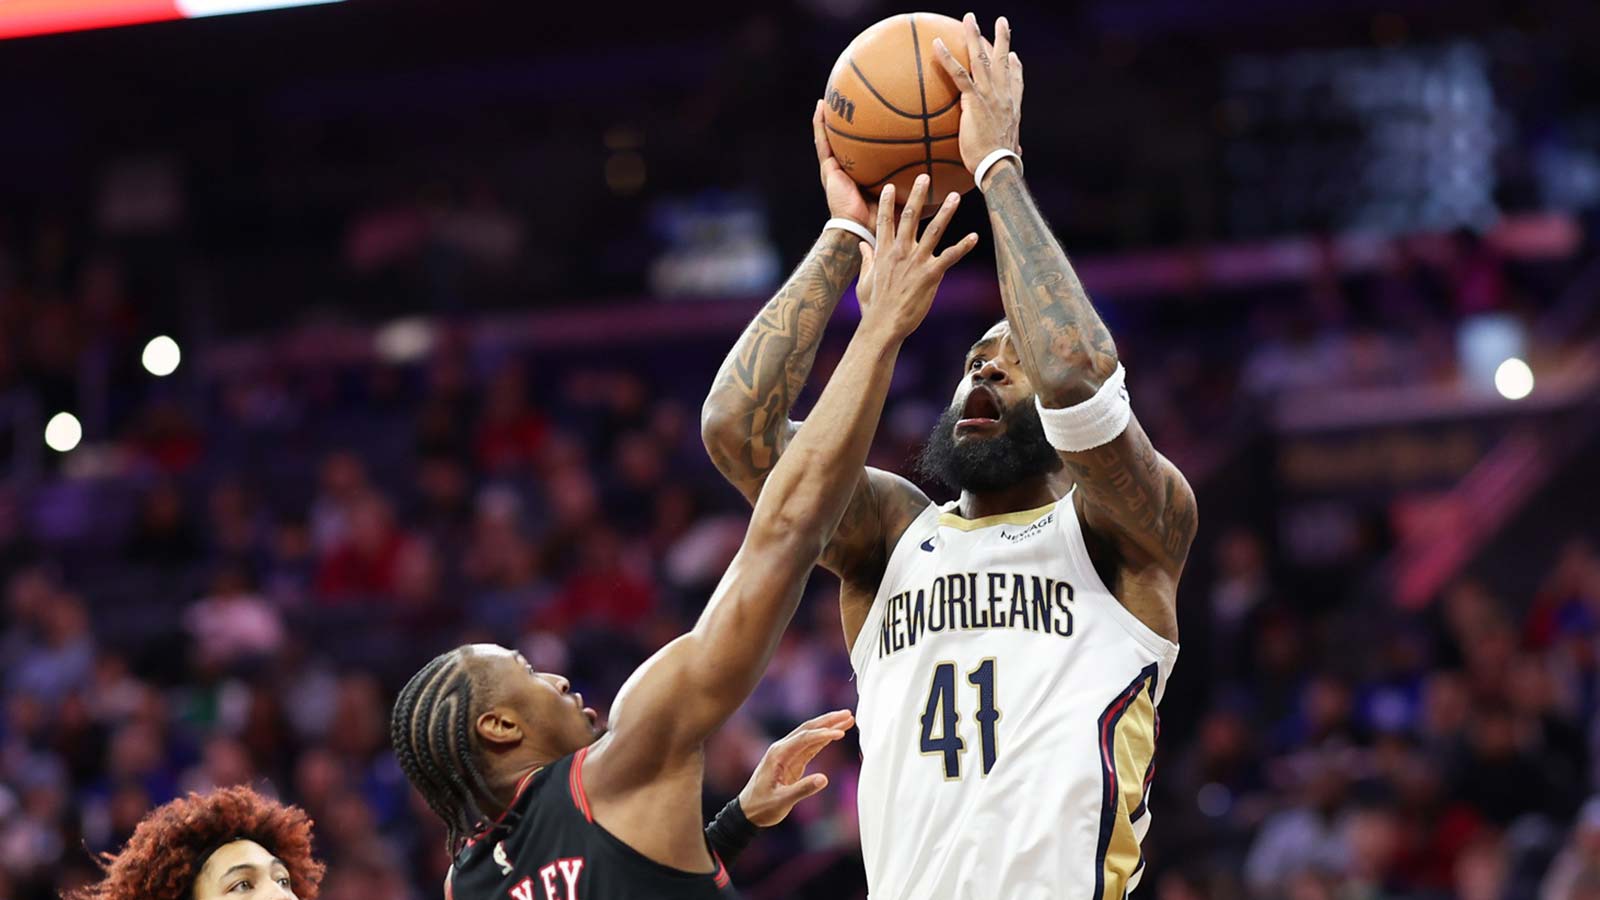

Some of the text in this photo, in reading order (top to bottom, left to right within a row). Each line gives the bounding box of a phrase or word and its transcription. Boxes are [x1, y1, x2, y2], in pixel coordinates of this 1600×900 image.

[878, 571, 1075, 660] NEW ORLEANS
[918, 656, 1003, 782] 41
